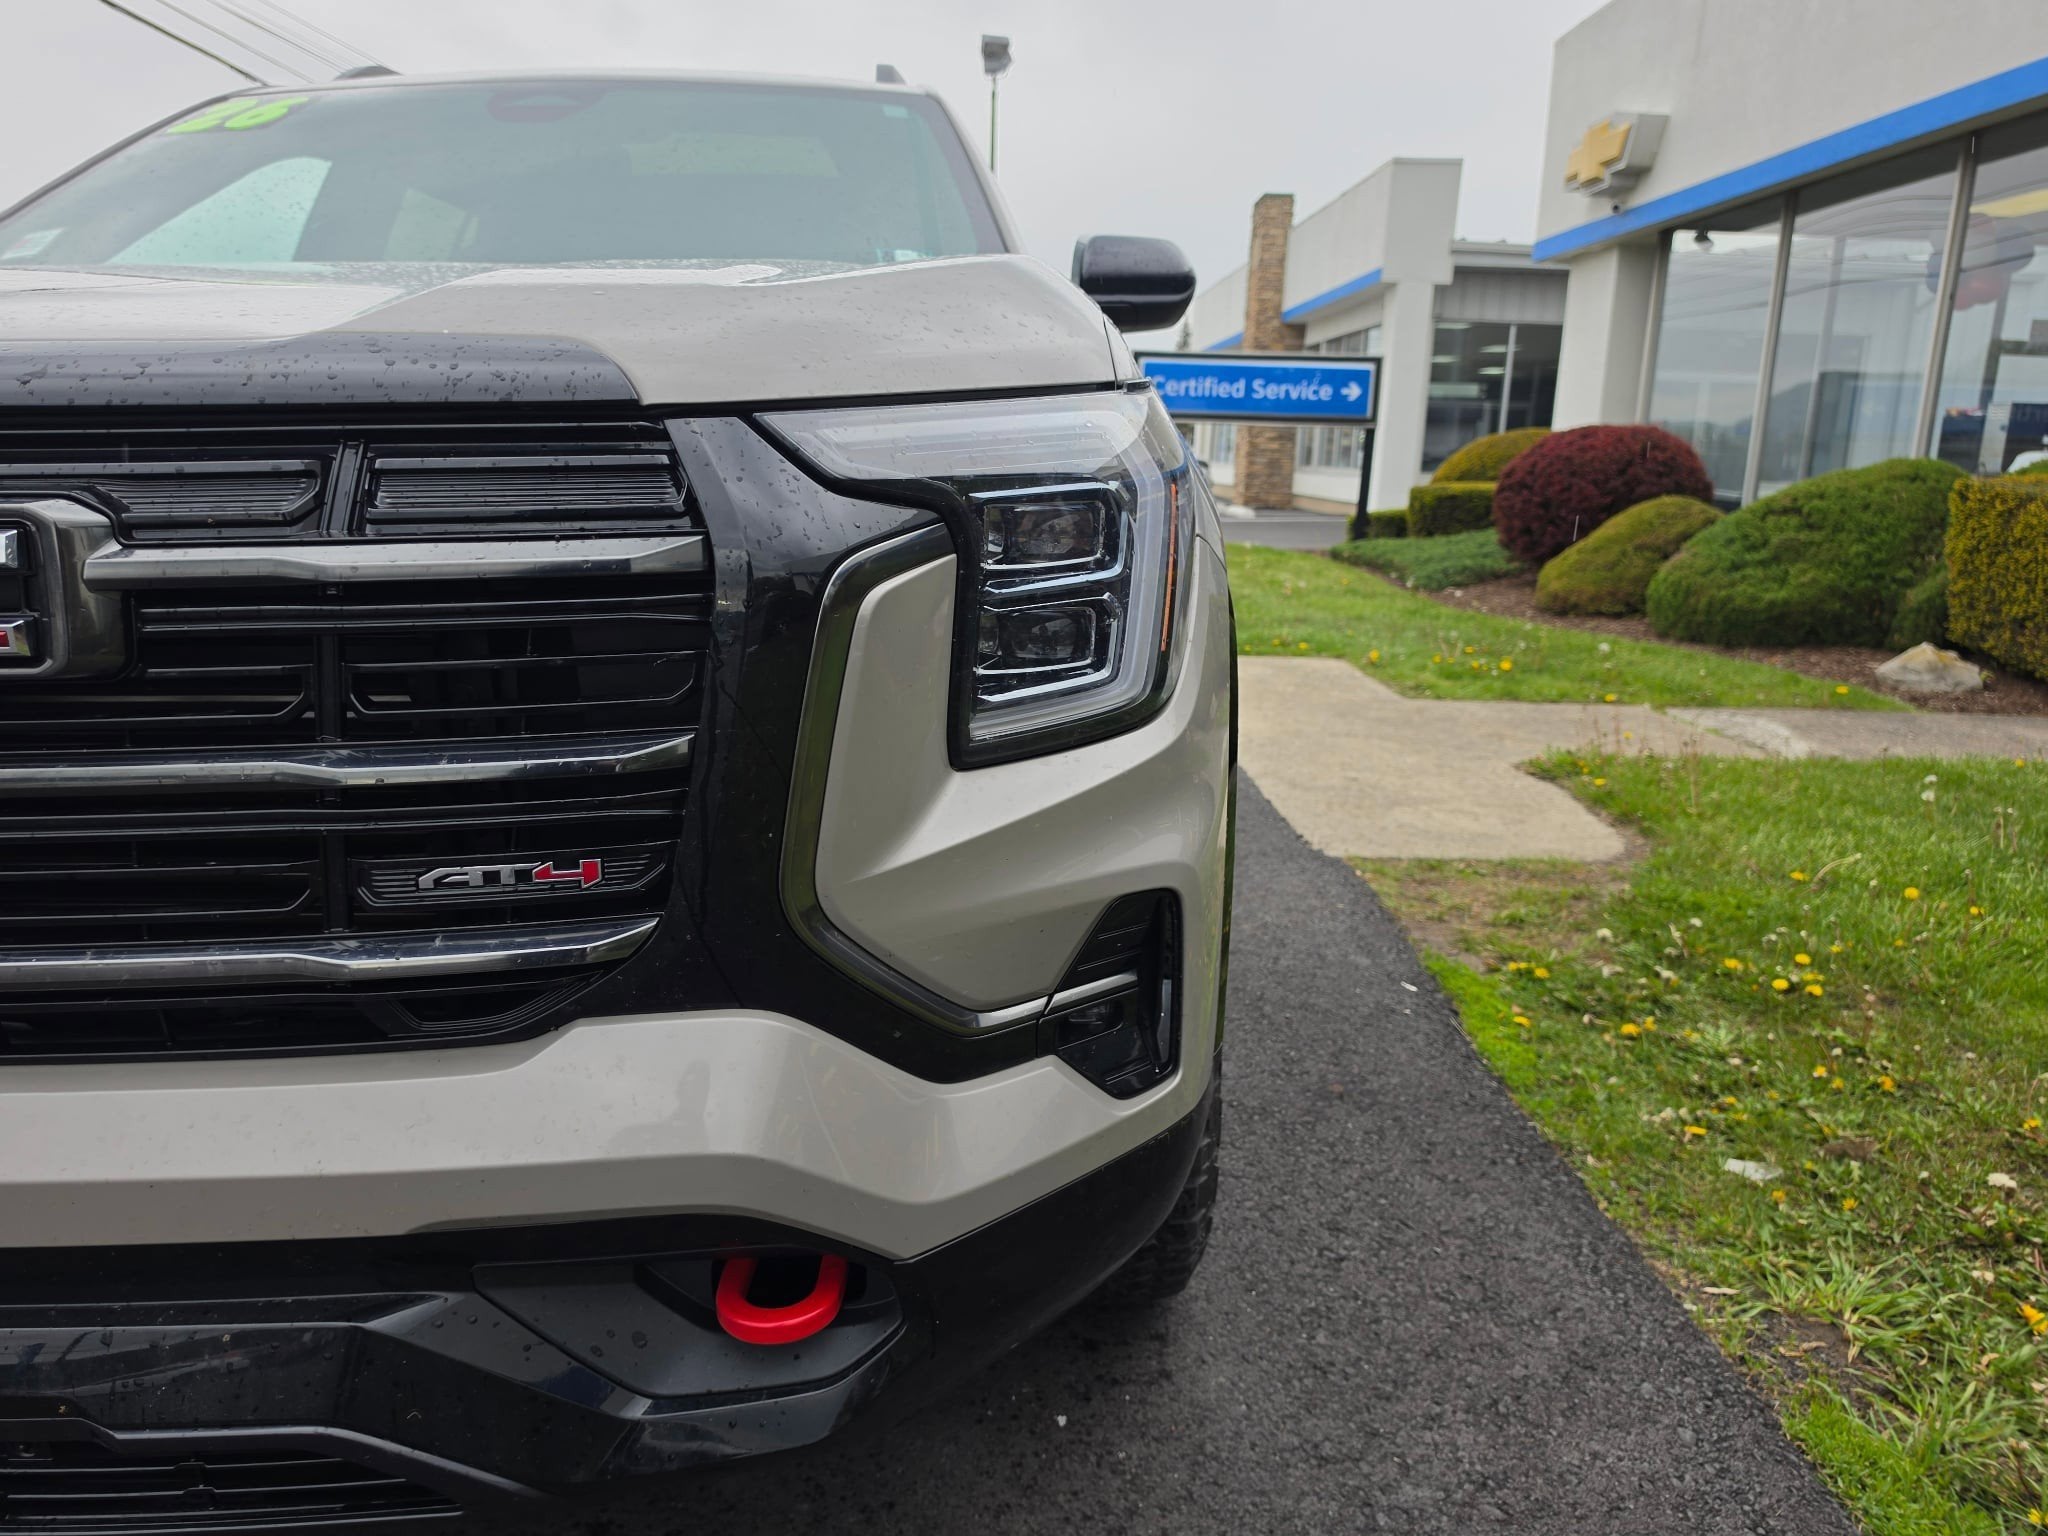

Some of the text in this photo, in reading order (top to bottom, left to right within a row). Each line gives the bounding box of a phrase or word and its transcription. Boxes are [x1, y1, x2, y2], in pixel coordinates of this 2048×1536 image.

[1152, 374, 1333, 401] Certified Service
[418, 858, 602, 889] AT4
